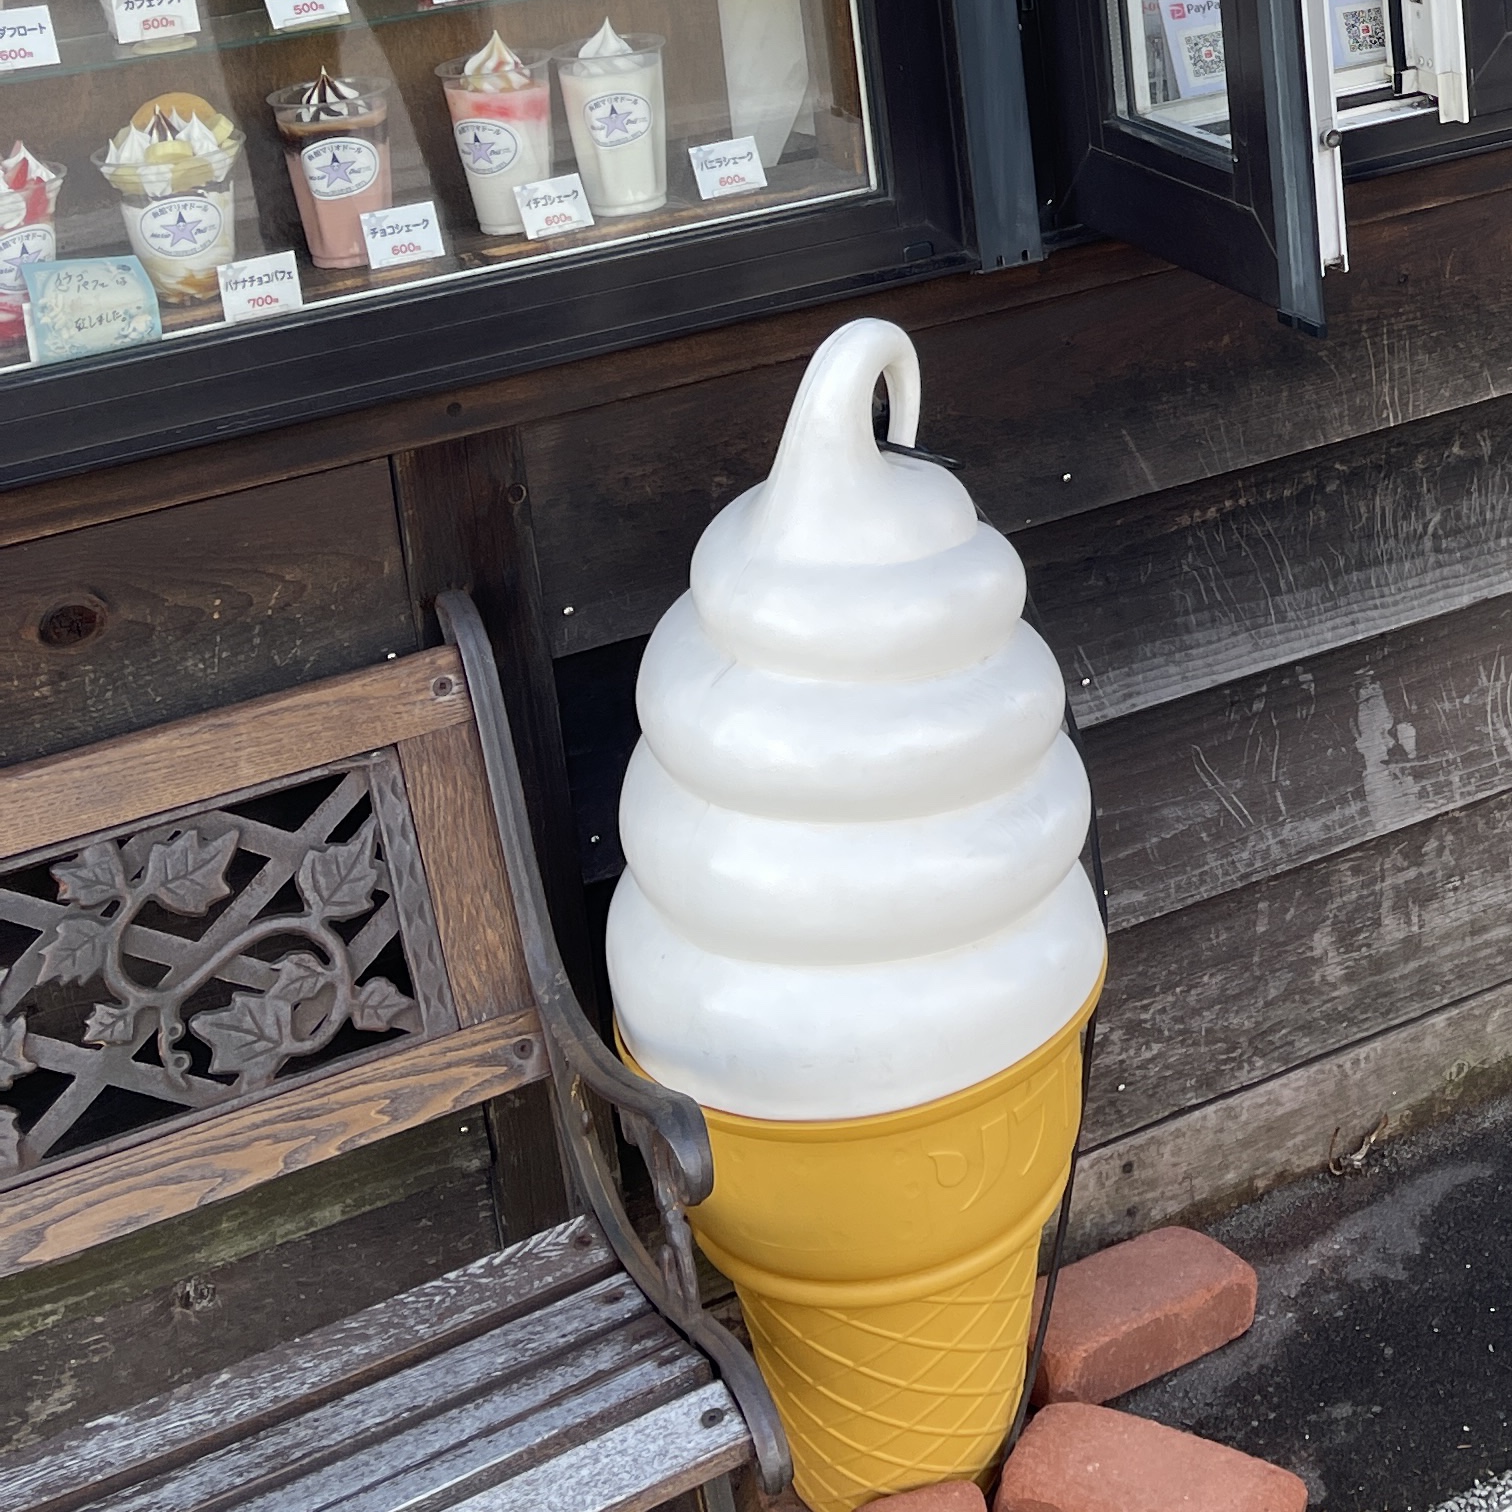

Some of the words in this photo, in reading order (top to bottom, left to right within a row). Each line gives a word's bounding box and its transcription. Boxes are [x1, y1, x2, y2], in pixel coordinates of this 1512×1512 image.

[293, 1, 325, 16] 500円
[1186, 0, 1221, 15] PayPa
[142, 16, 175, 31] 500円
[700, 152, 754, 171] バニラシェーク
[718, 174, 746, 187] 600円
[525, 189, 579, 210] イチゴシェーク
[544, 213, 573, 226] 600円
[370, 218, 429, 239] チョコシェーク
[391, 242, 421, 256] 600円
[225, 270, 294, 293] バナナチョコパフェ
[247, 294, 279, 309] 700円
